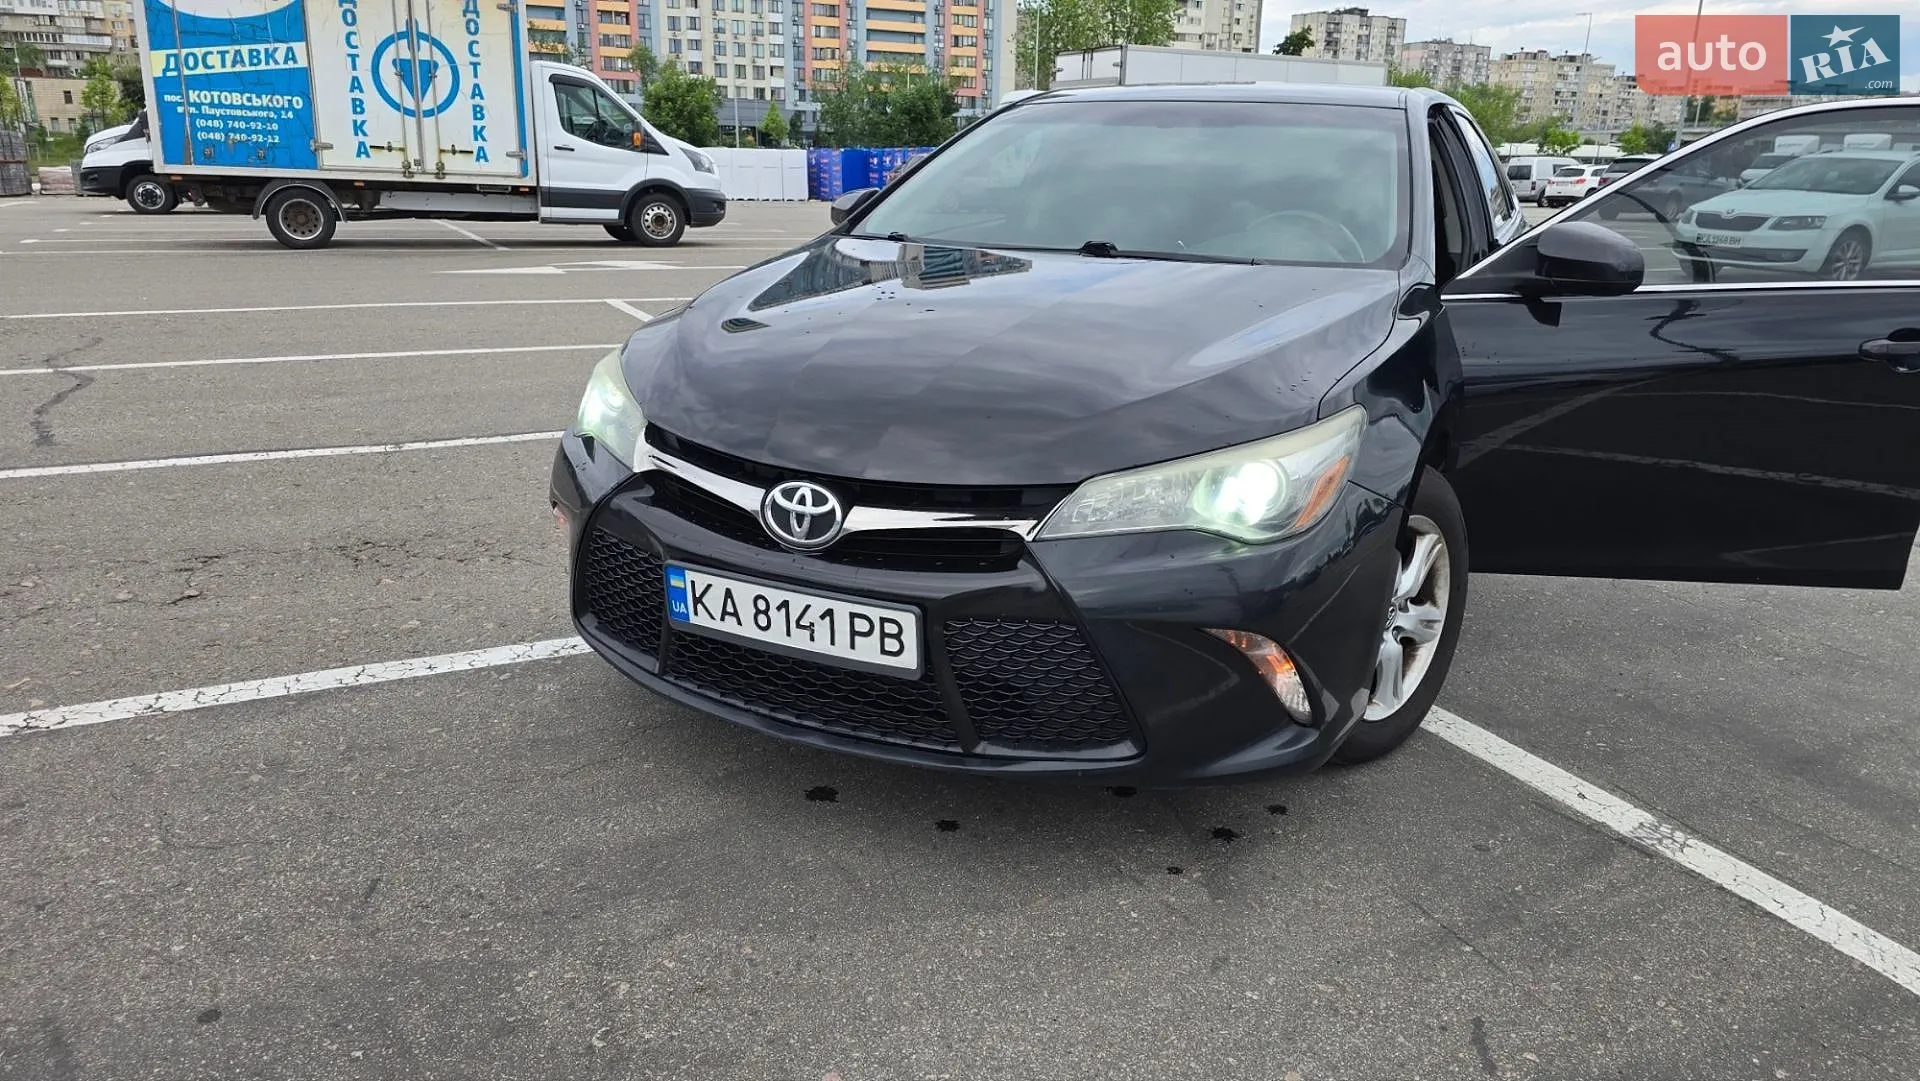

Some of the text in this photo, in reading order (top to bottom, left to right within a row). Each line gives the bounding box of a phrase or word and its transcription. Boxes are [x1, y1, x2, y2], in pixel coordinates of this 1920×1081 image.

[162, 46, 299, 77] ДОСТАВКА
[188, 89, 304, 109] КОТОВСЬКОГО
[176, 105, 199, 114] вл.
[201, 105, 278, 119] Паустовського,
[195, 118, 279, 131] (048) 740-92-10
[197, 131, 280, 143] (048) 740-92-12
[672, 601, 688, 615] UA
[690, 579, 905, 658] KA 8141 PB
